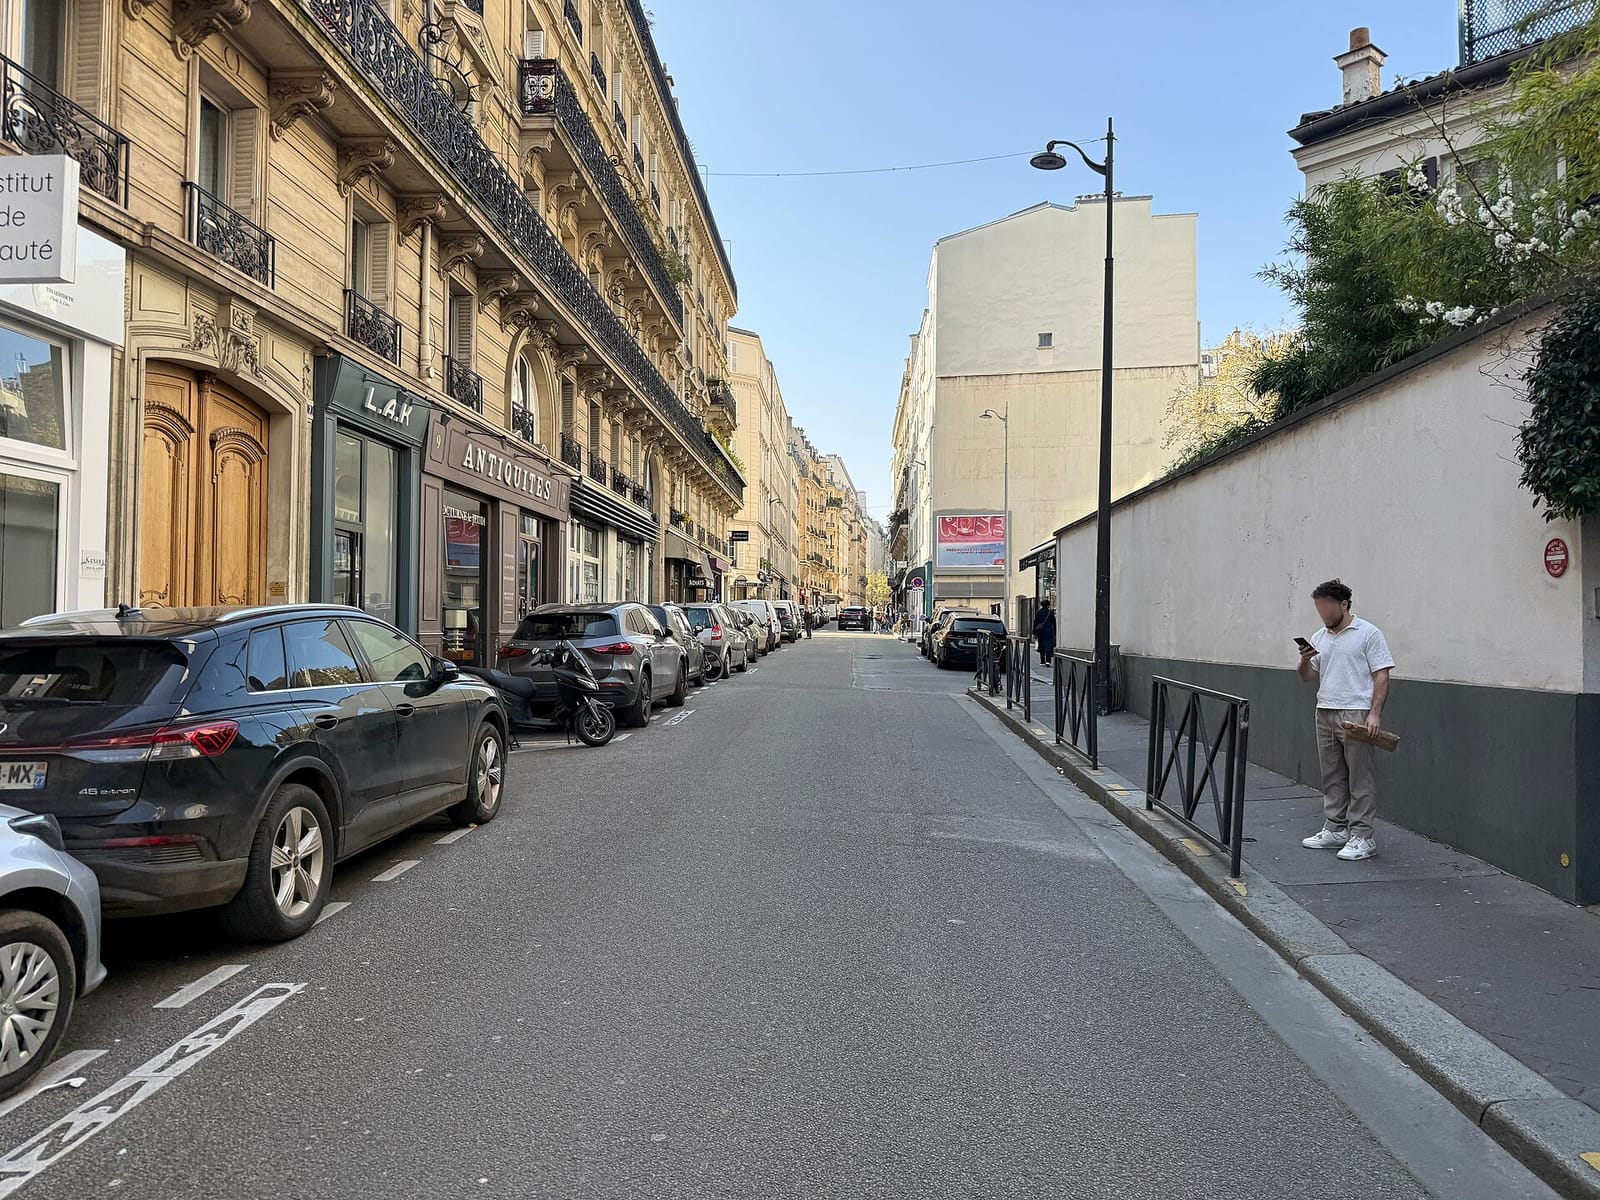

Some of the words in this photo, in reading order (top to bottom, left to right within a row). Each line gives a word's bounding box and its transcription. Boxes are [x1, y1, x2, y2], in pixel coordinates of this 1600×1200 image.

[0, 204, 26, 227] de
[0, 239, 53, 261] auté
[436, 434, 442, 449] 9
[461, 442, 552, 501] ANTIQUITES
[0, 764, 34, 784] -MX
[79, 787, 98, 795] 45
